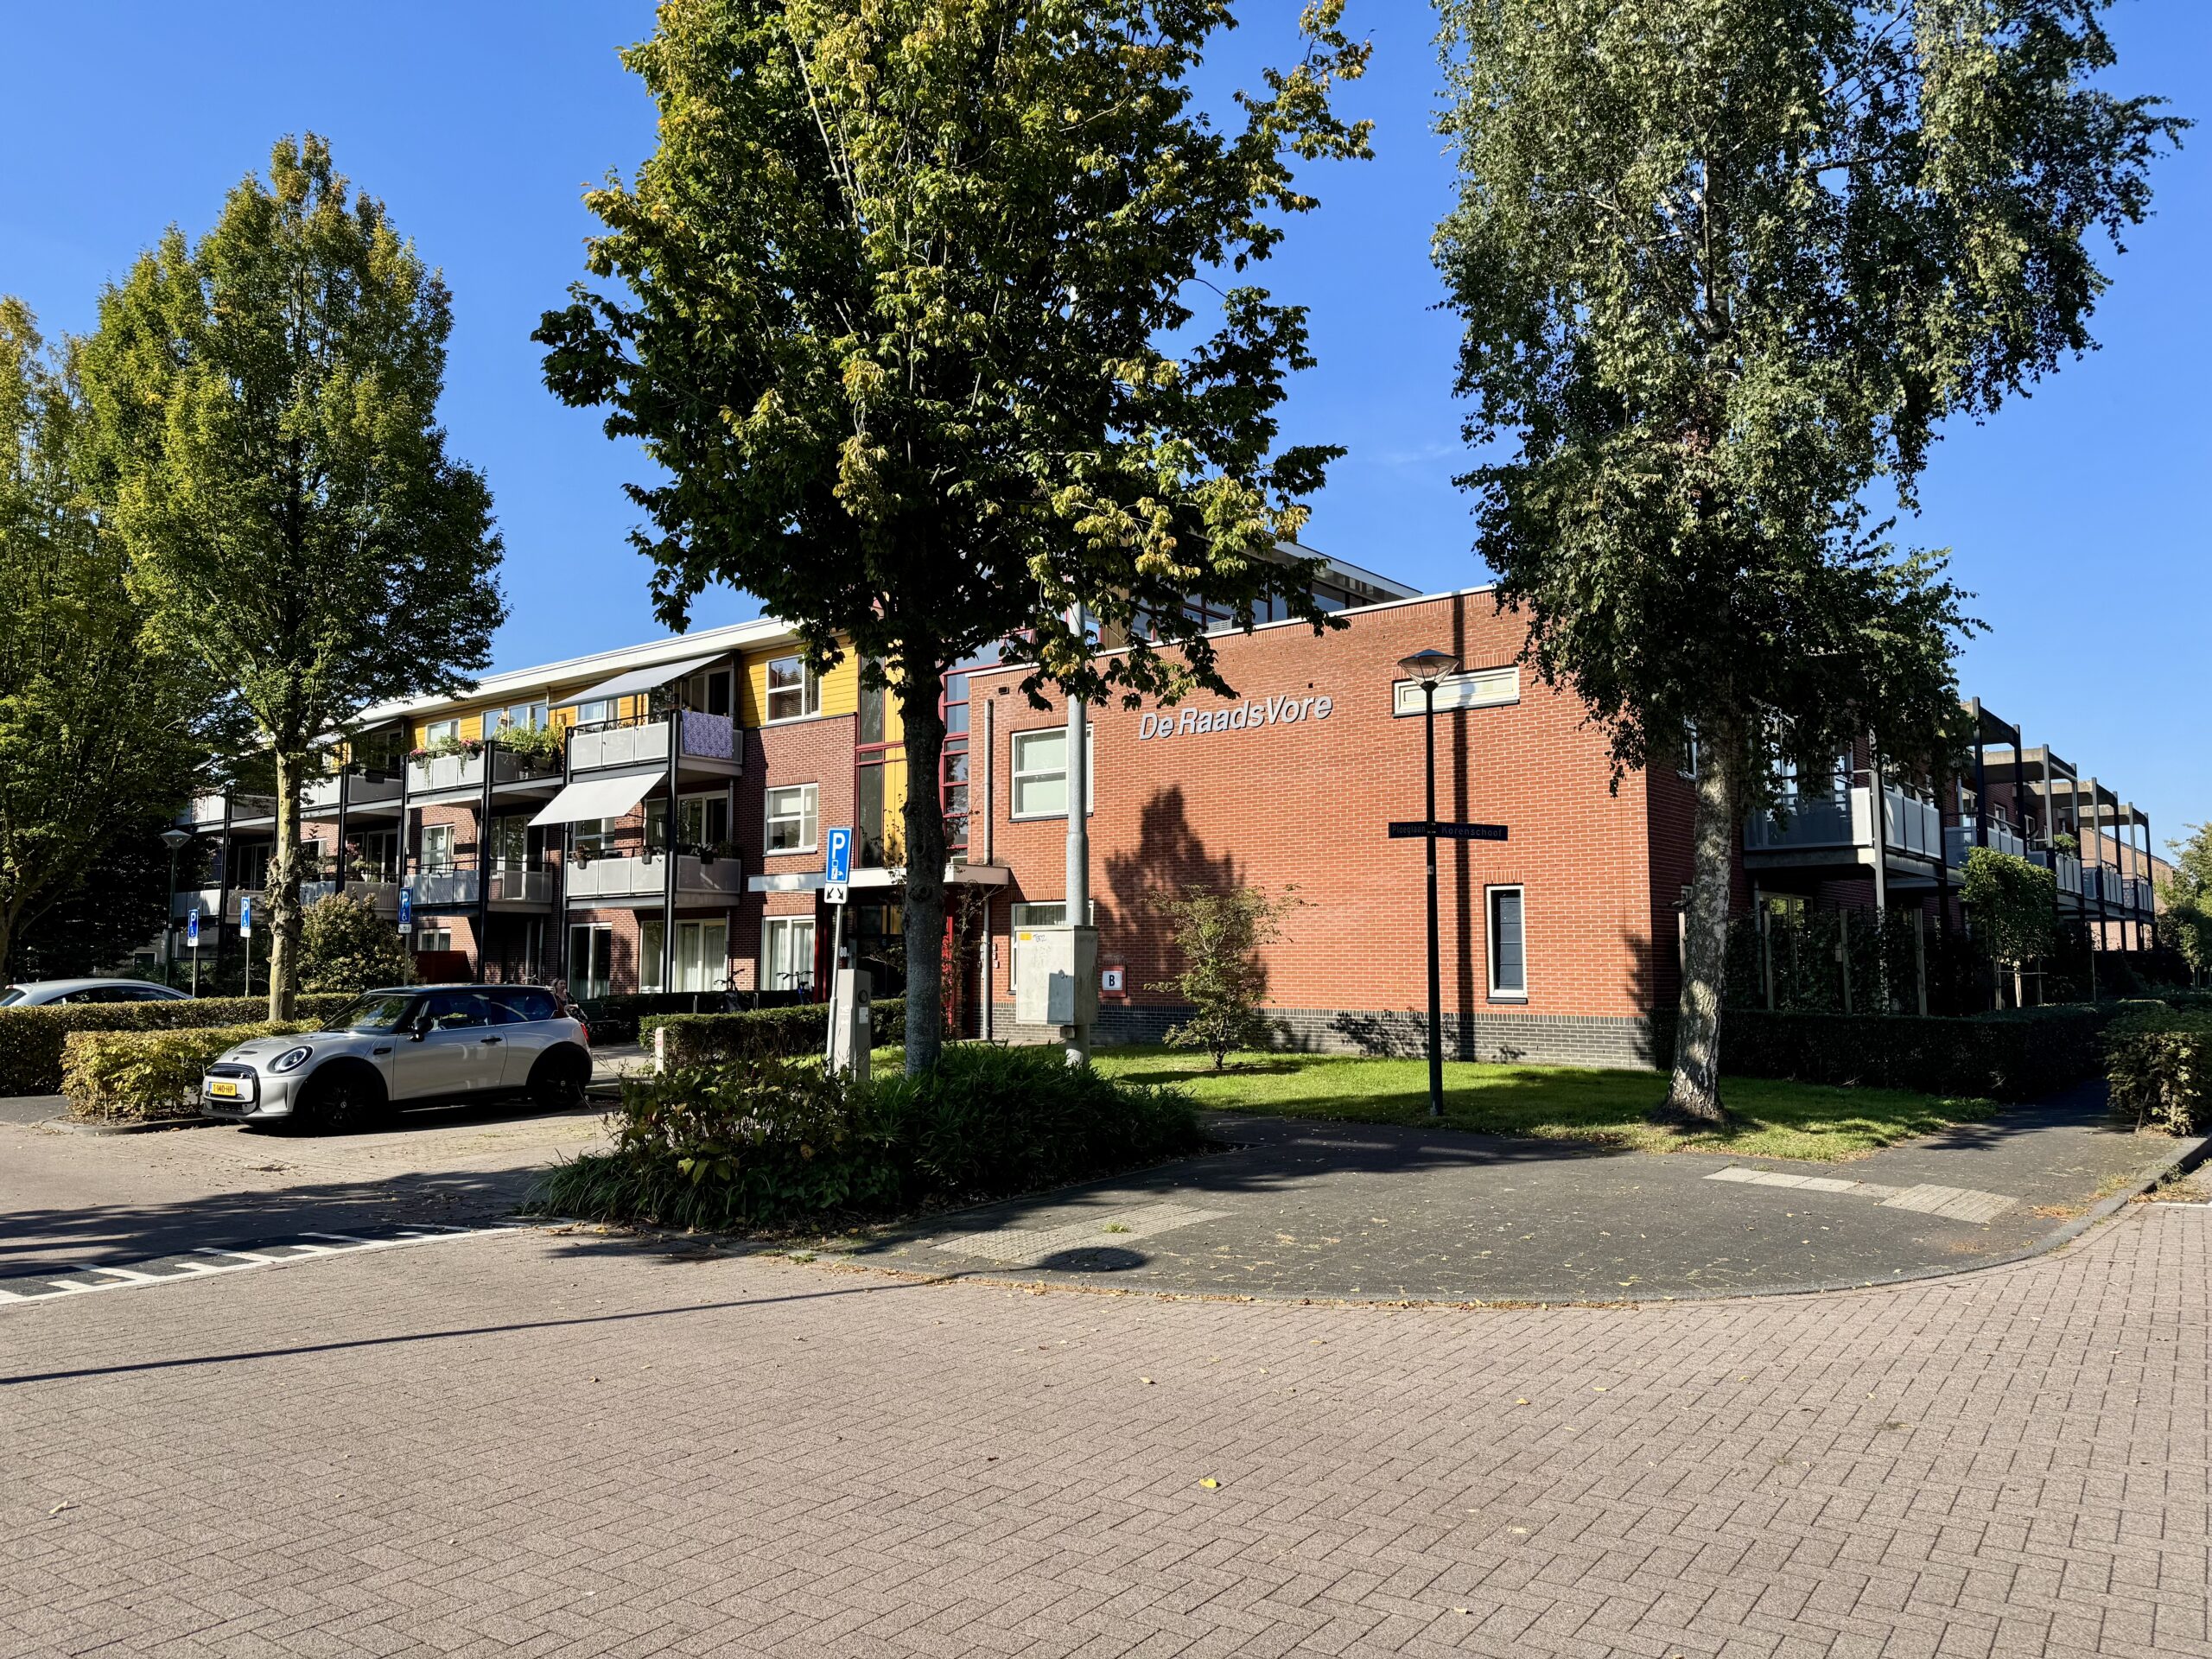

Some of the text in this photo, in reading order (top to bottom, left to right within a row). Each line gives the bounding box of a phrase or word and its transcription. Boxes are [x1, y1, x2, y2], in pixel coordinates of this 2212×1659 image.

[1139, 712, 1174, 741] De
[1392, 825, 1426, 836] Ploeglaan
[1441, 826, 1502, 837] Korenschoof
[832, 832, 846, 860] P
[243, 900, 249, 916] P
[190, 912, 196, 927] P
[1109, 975, 1116, 987] B
